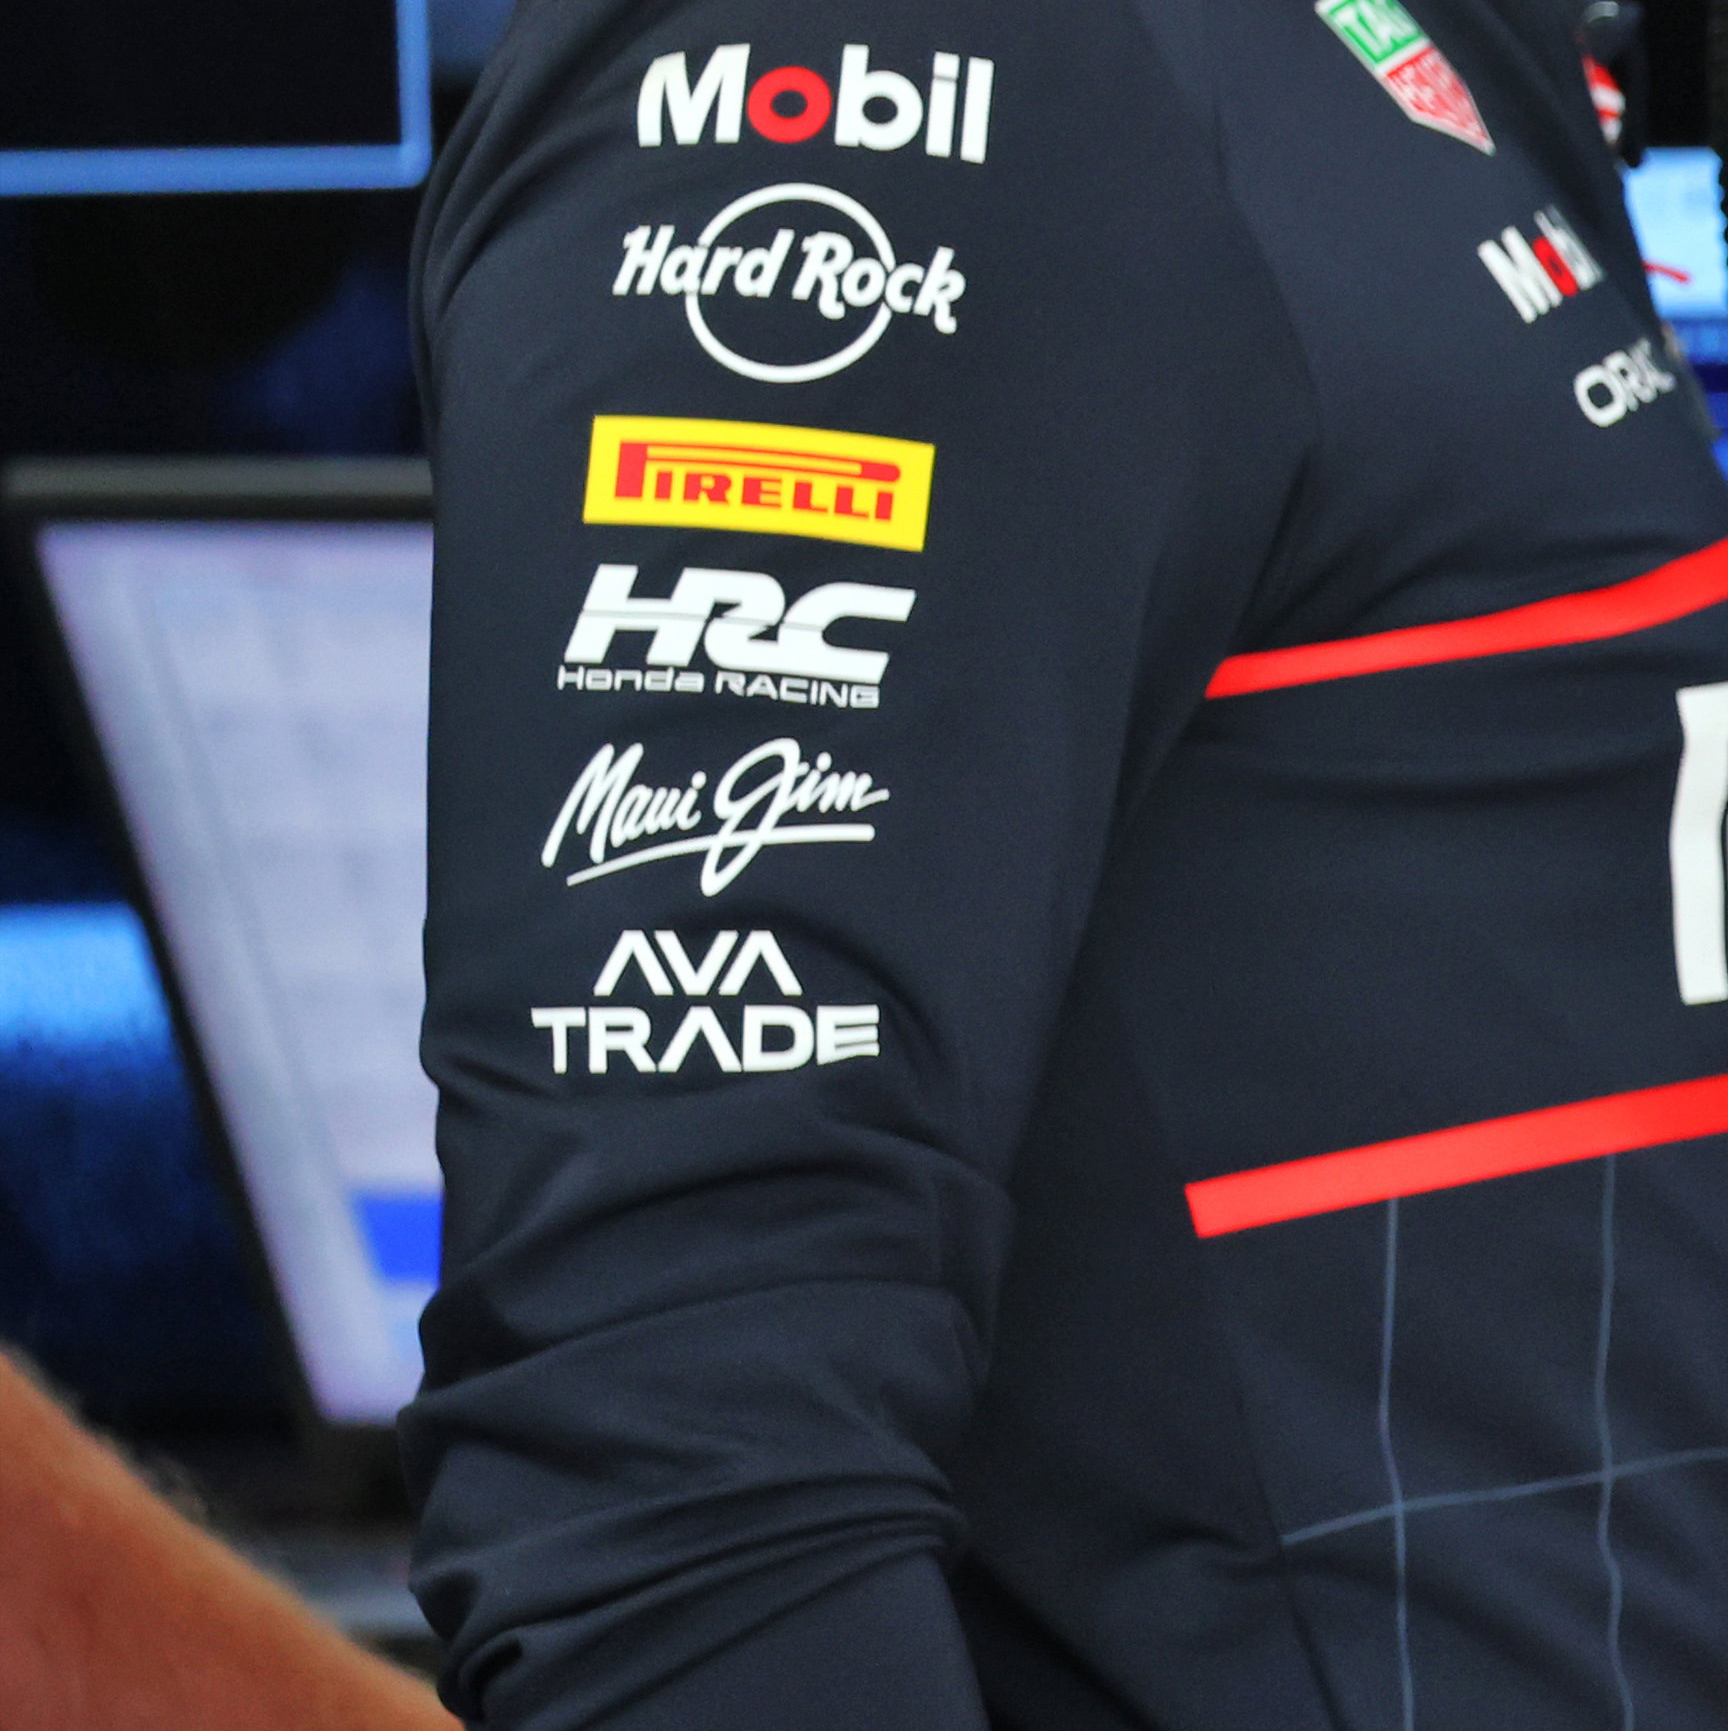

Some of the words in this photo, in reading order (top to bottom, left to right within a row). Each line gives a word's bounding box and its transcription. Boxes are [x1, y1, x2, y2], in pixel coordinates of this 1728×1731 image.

[637, 43, 994, 163] Mobil
[612, 225, 794, 297] Hard
[792, 231, 966, 334] Rock
[615, 439, 900, 522] PIRELLI
[564, 564, 916, 684] HRC
[557, 665, 704, 693] Honda
[714, 671, 880, 709] RACING
[541, 743, 706, 868] Maui
[701, 737, 890, 897] Jim
[593, 930, 802, 996] AVA
[531, 1004, 880, 1074] TRADE
